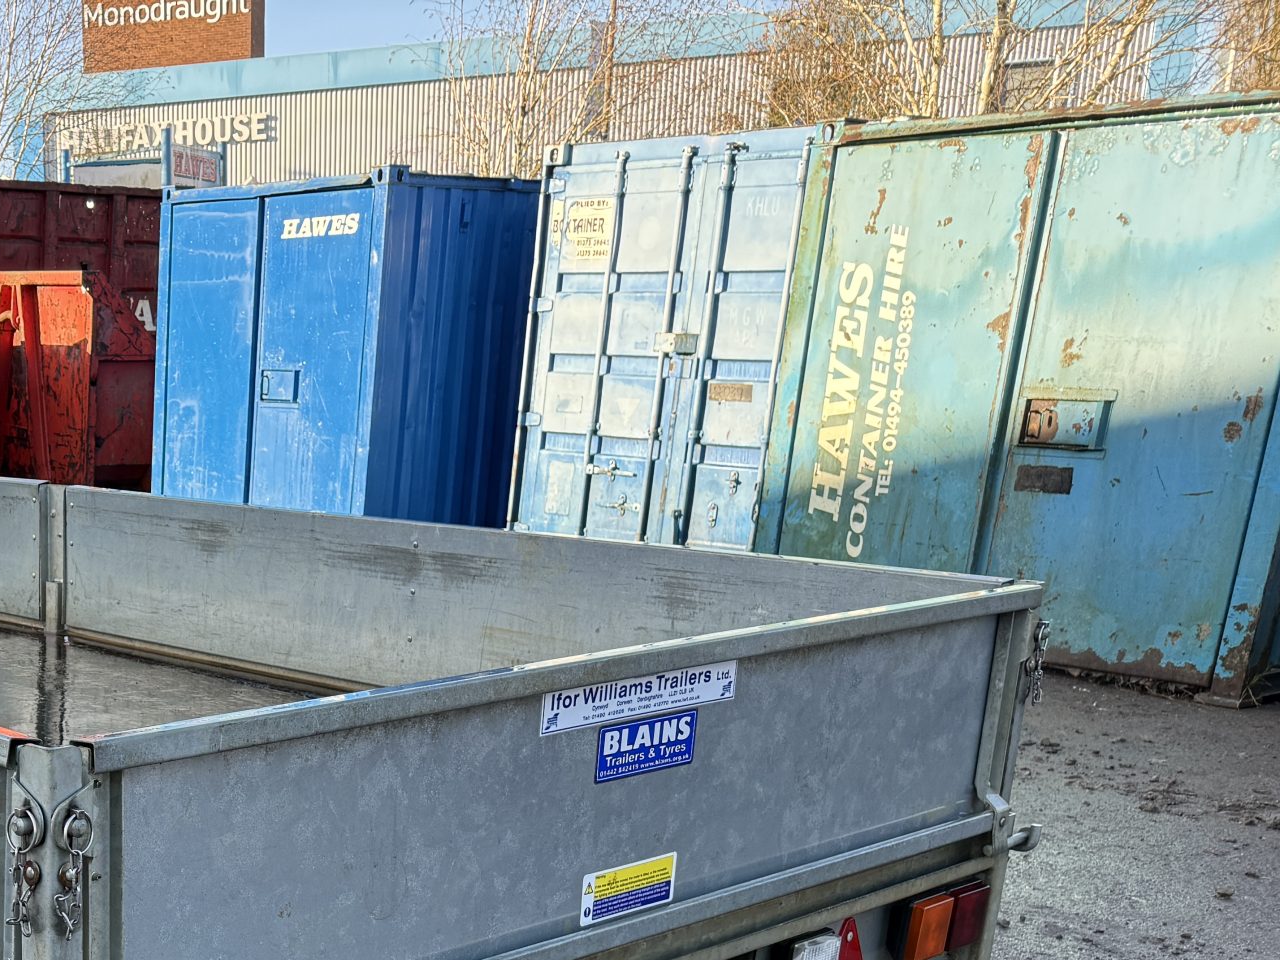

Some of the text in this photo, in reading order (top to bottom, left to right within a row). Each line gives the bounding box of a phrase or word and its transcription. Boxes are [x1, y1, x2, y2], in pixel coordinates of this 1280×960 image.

[84, 0, 250, 29] Monodraught
[174, 112, 269, 146] HOUSE
[173, 151, 217, 183] HAWES
[281, 212, 360, 239] HAWES
[808, 261, 873, 522] HAWES
[846, 223, 910, 558] CONTAINER HIRE
[875, 290, 918, 496] TEL: 01494-450389
[550, 669, 732, 712] Ifor Williams Trailers Ltd.
[603, 716, 691, 756] BLAINS
[606, 743, 686, 767] Trailers & Tyres
